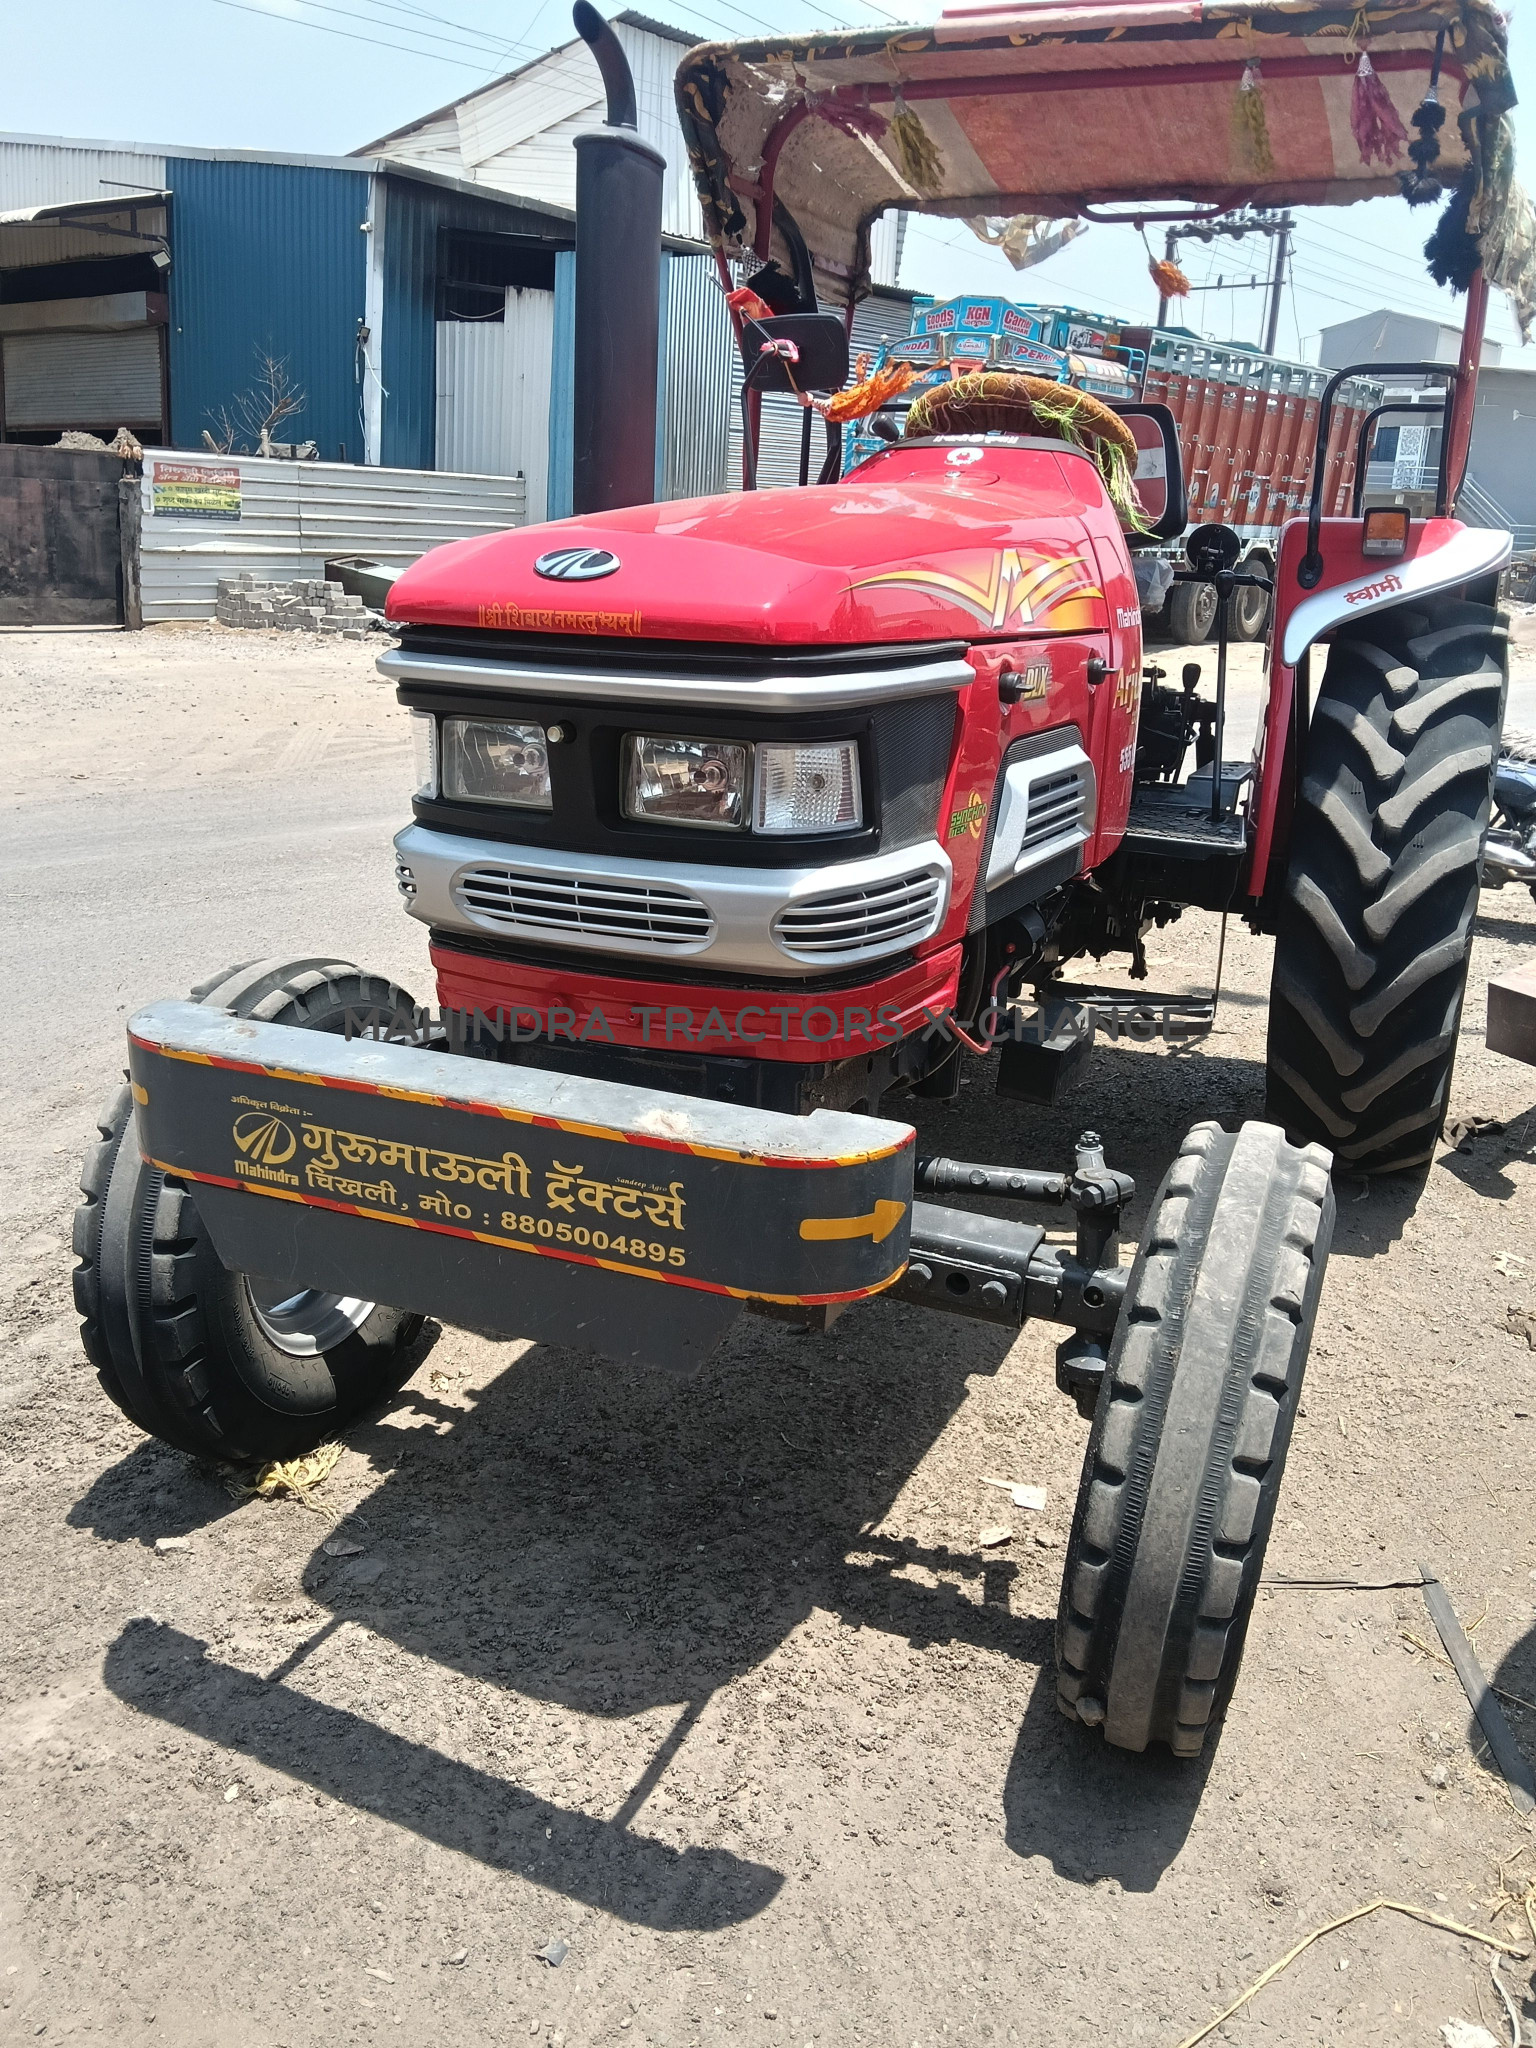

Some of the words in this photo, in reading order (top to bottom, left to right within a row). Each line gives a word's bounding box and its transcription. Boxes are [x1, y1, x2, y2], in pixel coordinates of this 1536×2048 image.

[927, 309, 955, 325] Goods
[965, 307, 991, 320] KGN
[904, 340, 931, 351] INDIA
[1015, 345, 1056, 361] PERMIT
[1343, 574, 1403, 605] स्वामी
[231, 1095, 268, 1109] अधिकृत
[234, 1159, 299, 1186] Mahindra
[614, 1176, 647, 1189] Sandeep
[648, 1183, 668, 1192] Agro
[545, 1160, 686, 1230] ट्रॅक्टर्स
[500, 1210, 686, 1266] 8805004895
